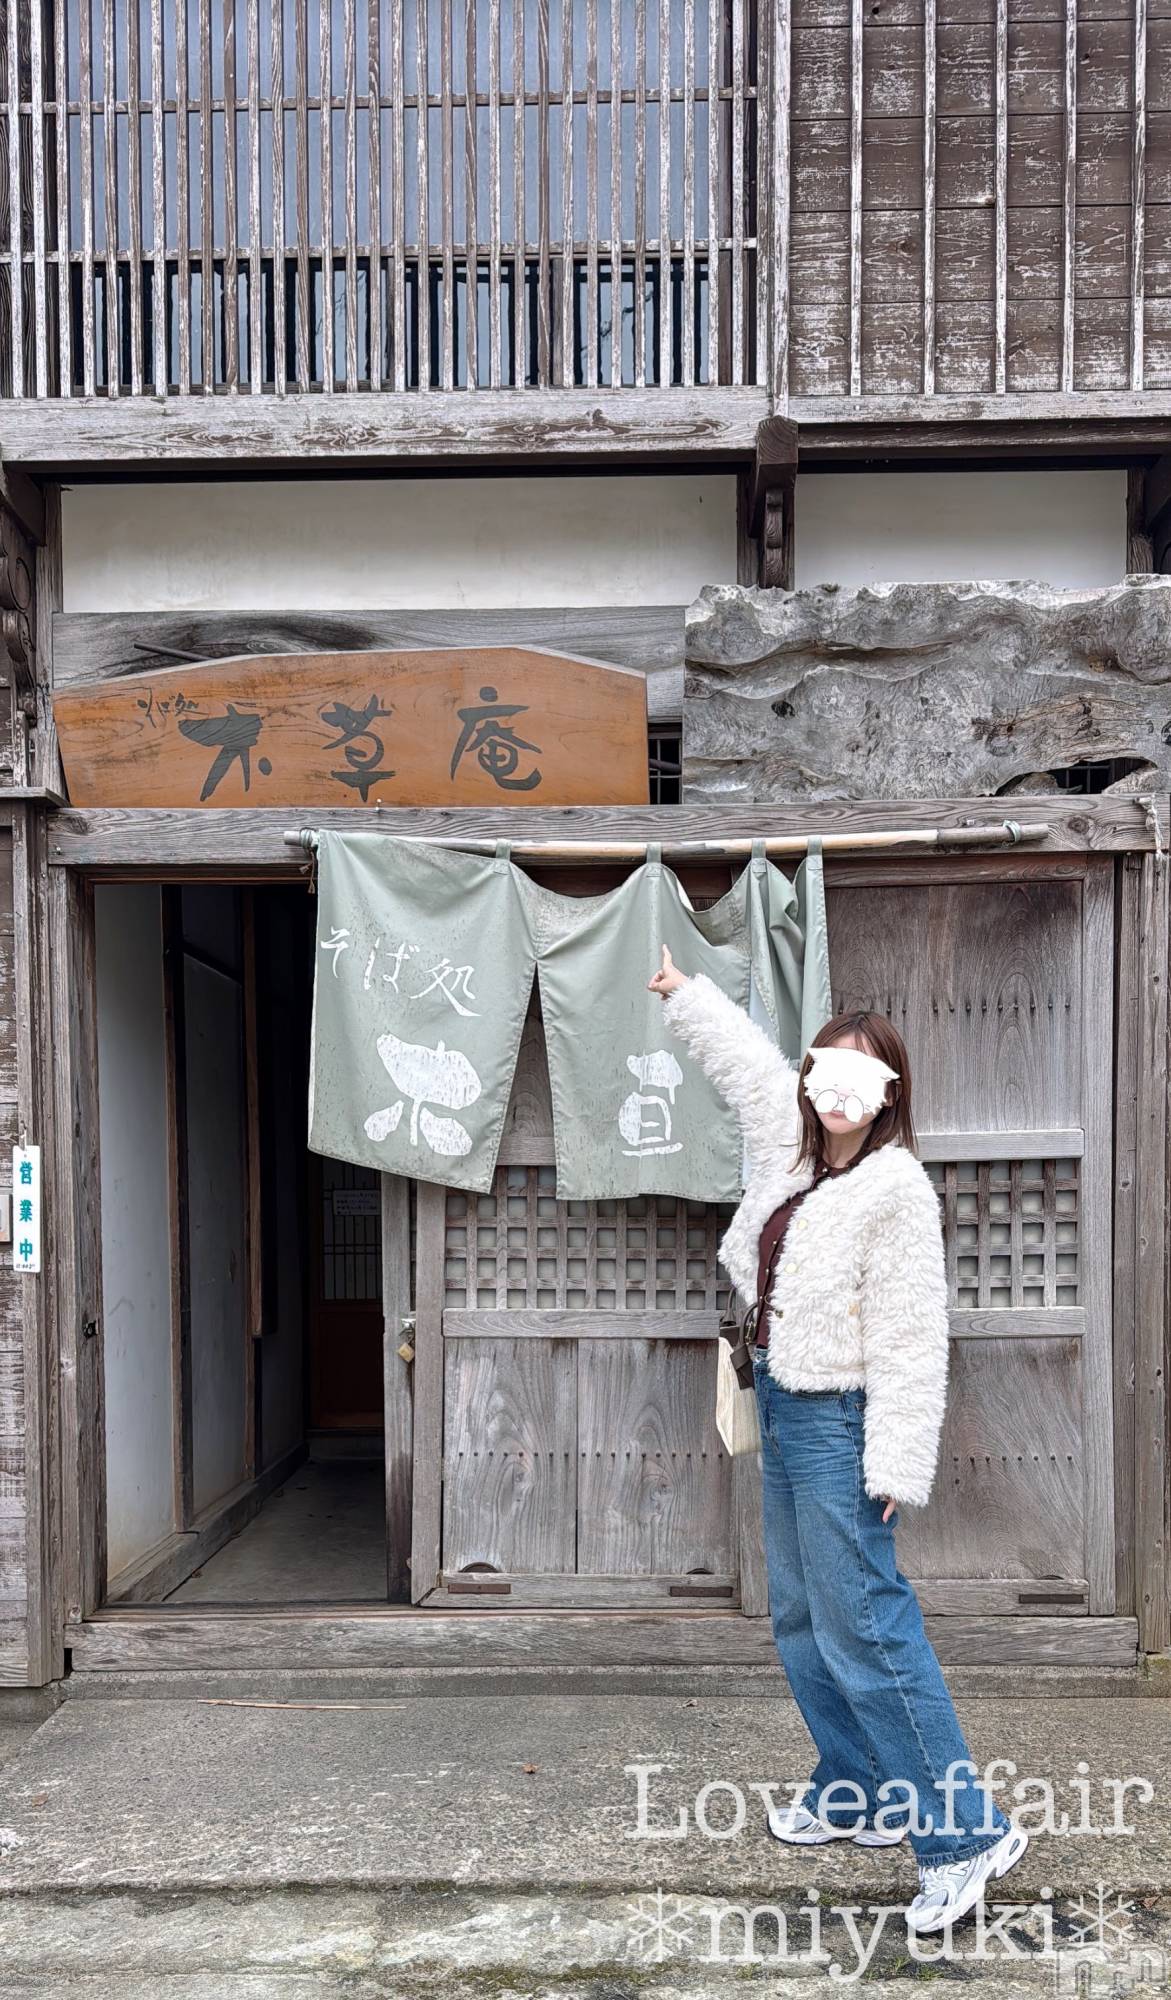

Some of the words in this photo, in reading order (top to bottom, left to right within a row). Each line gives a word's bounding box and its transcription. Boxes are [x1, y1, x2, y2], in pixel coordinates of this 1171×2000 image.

[320, 926, 482, 1017] そば処
[19, 1161, 33, 1262] 営業中
